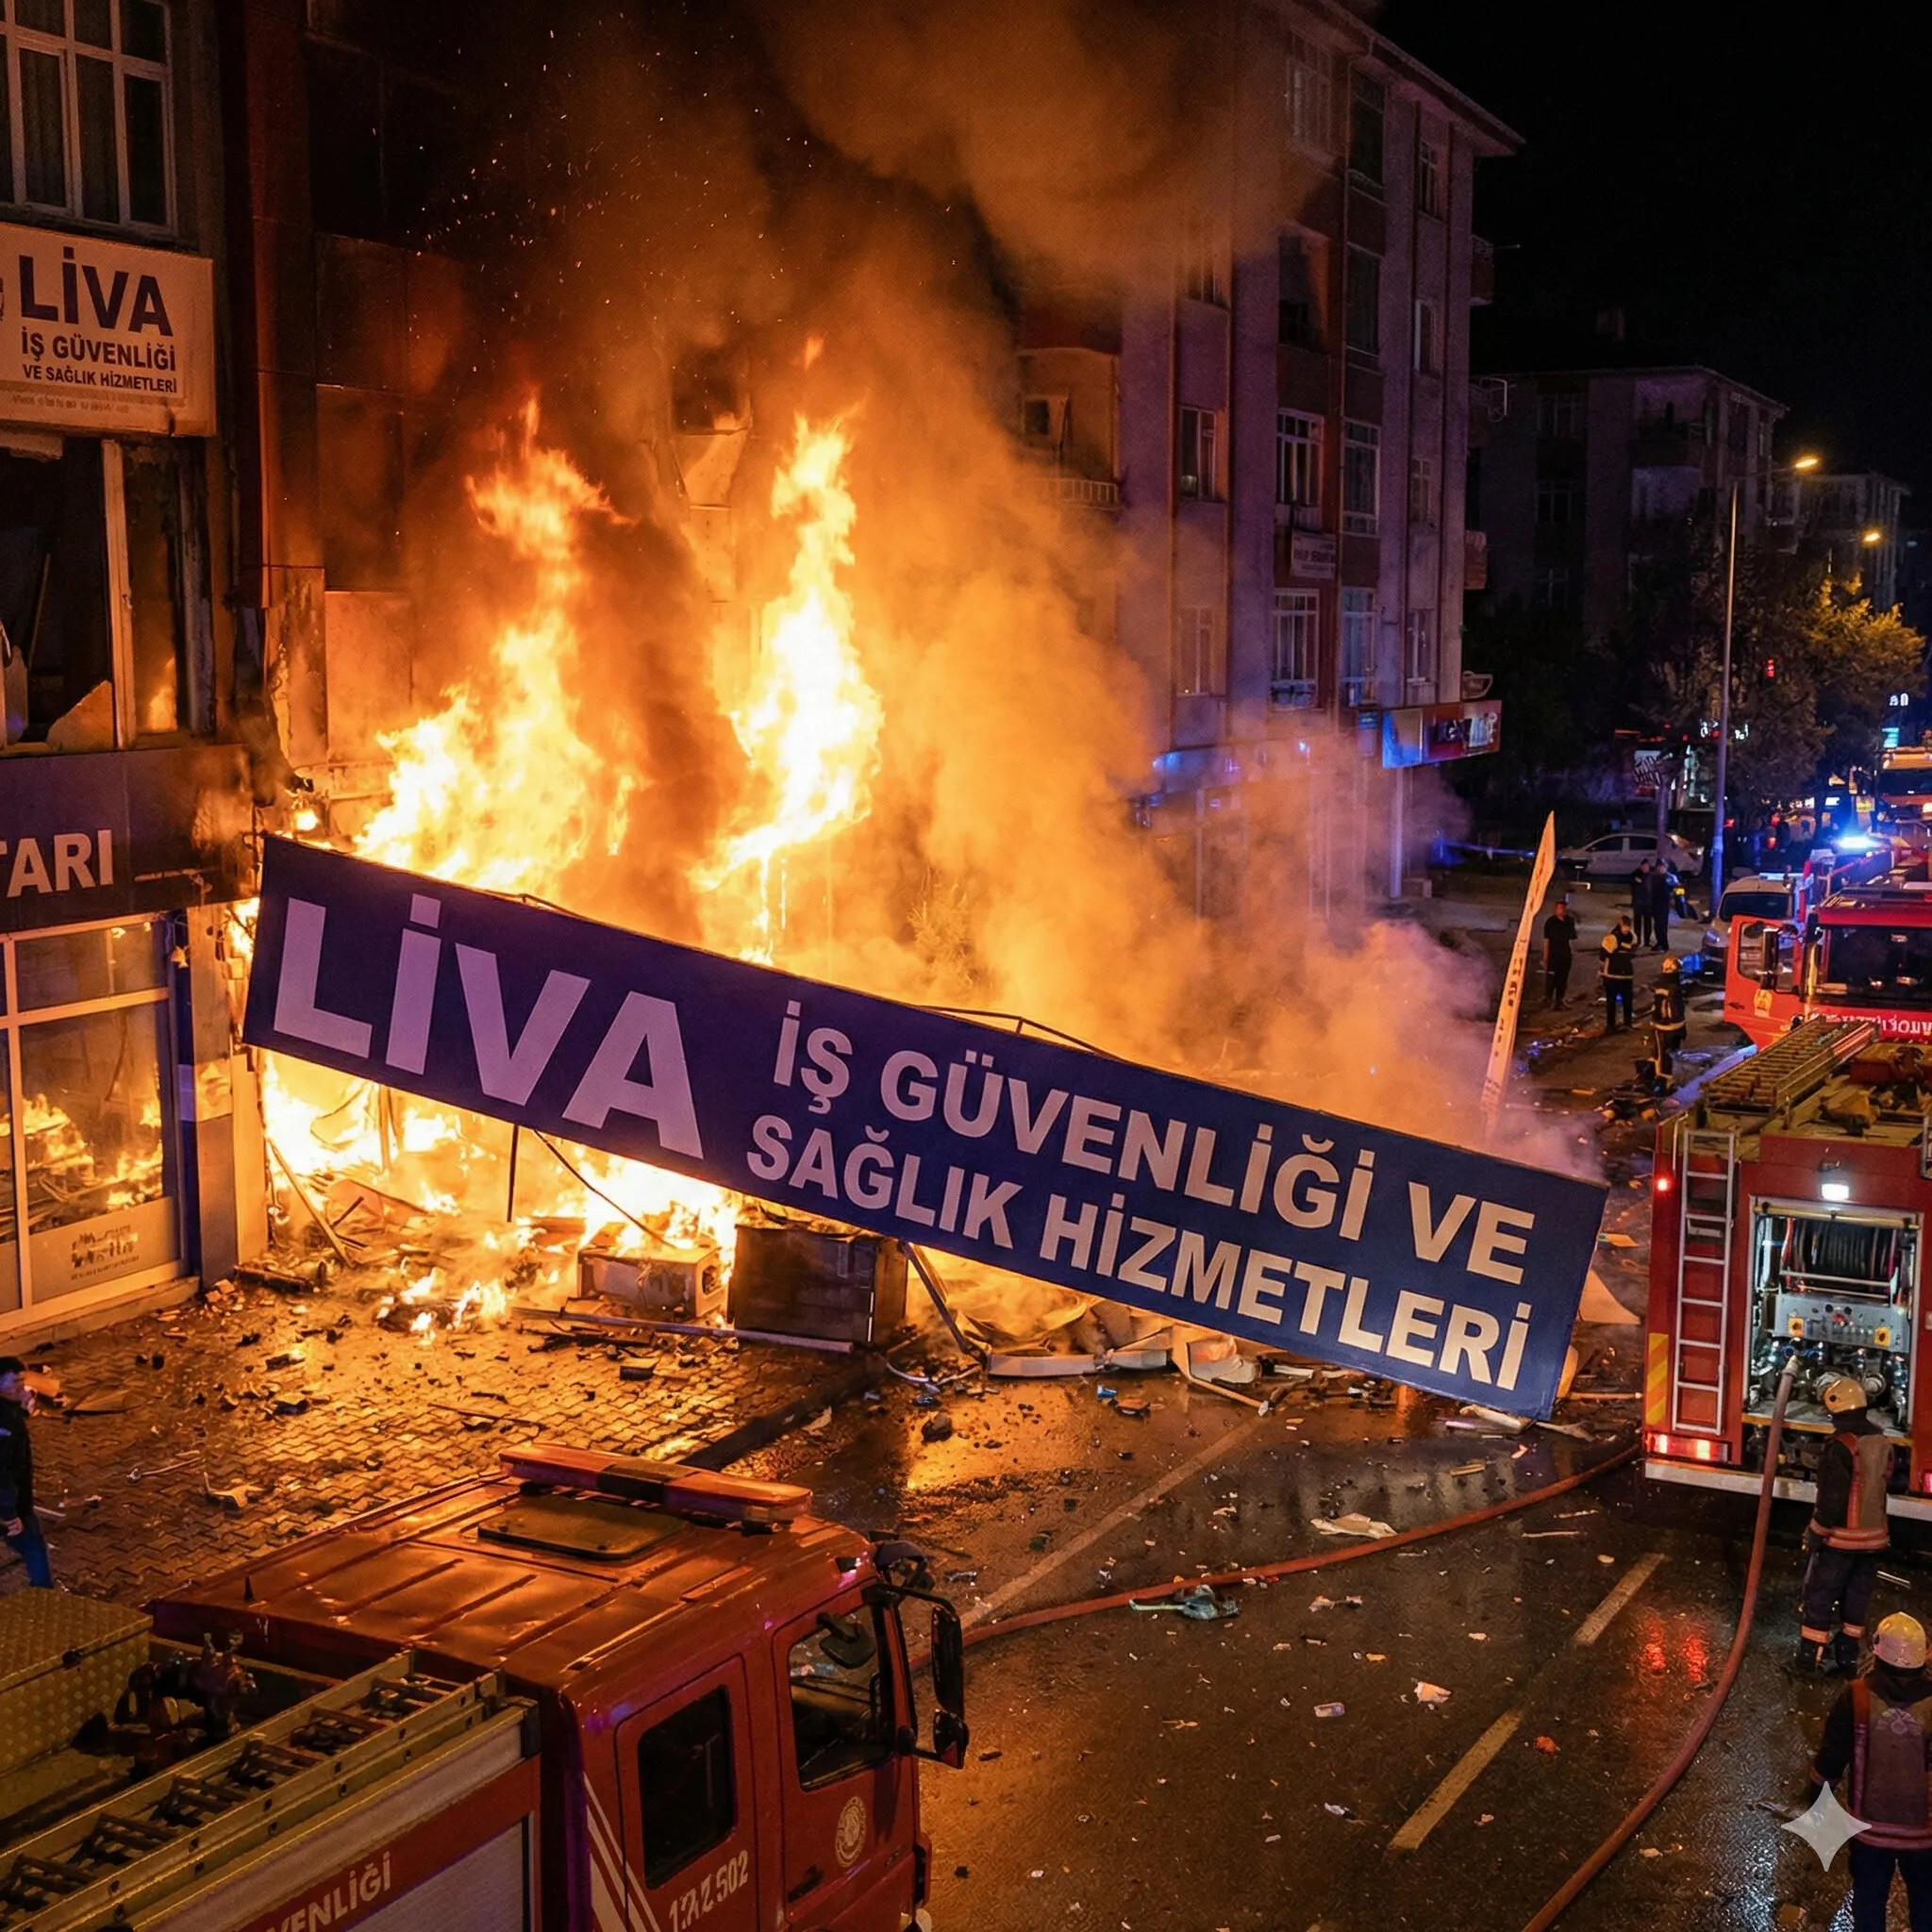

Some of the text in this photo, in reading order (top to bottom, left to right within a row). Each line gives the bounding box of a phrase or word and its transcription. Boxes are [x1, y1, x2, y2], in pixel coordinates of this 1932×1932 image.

[19, 246, 174, 337] LİVA
[22, 326, 176, 372] İŞ GÜVENLİĞİ
[23, 364, 177, 393] VE SAĞLIK HİZMETLERİ
[274, 893, 704, 1159] LİVA
[773, 1000, 1536, 1285] İŞ GÜVENLİĞİ VE
[746, 1114, 1533, 1391] SAĞLIK HİZMETLERİ
